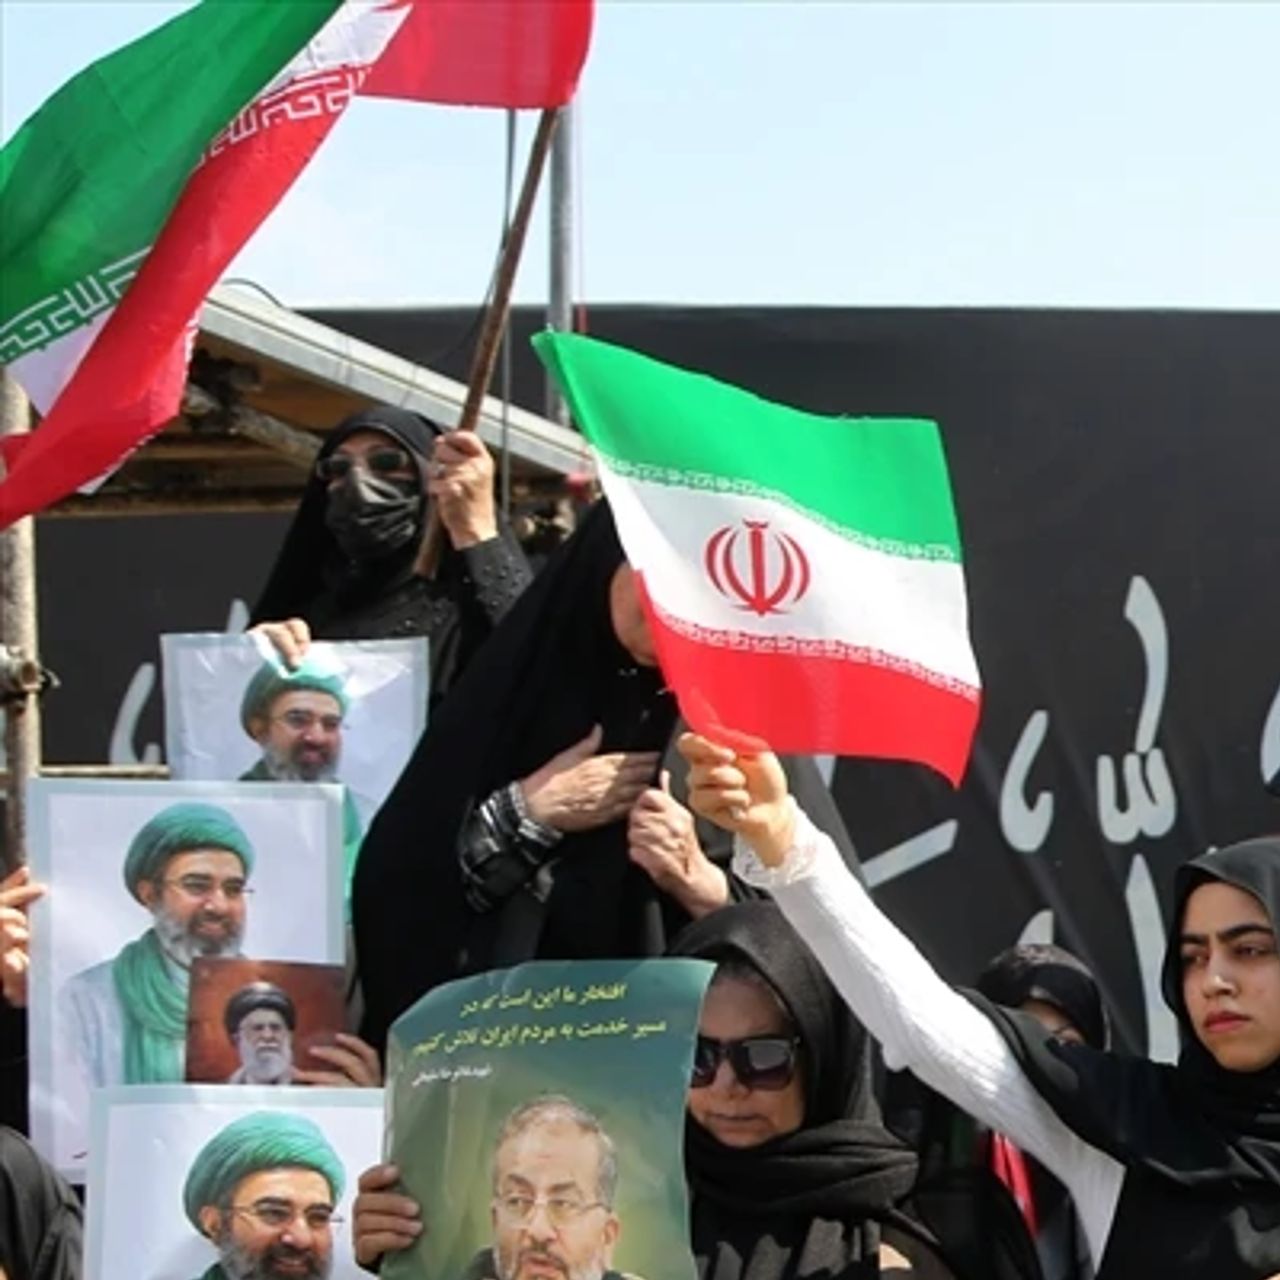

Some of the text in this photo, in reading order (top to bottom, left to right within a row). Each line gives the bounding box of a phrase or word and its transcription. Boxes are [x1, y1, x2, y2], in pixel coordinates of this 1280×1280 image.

[498, 987, 532, 1010] است
[532, 986, 561, 1010] این
[562, 983, 577, 1003] ما
[578, 982, 628, 1006] افتخار
[481, 1024, 520, 1049] ایران
[519, 1025, 557, 1046] مردم
[560, 1022, 574, 1041] به
[576, 1016, 629, 1038] خدمت
[631, 1019, 667, 1040] مسیر
